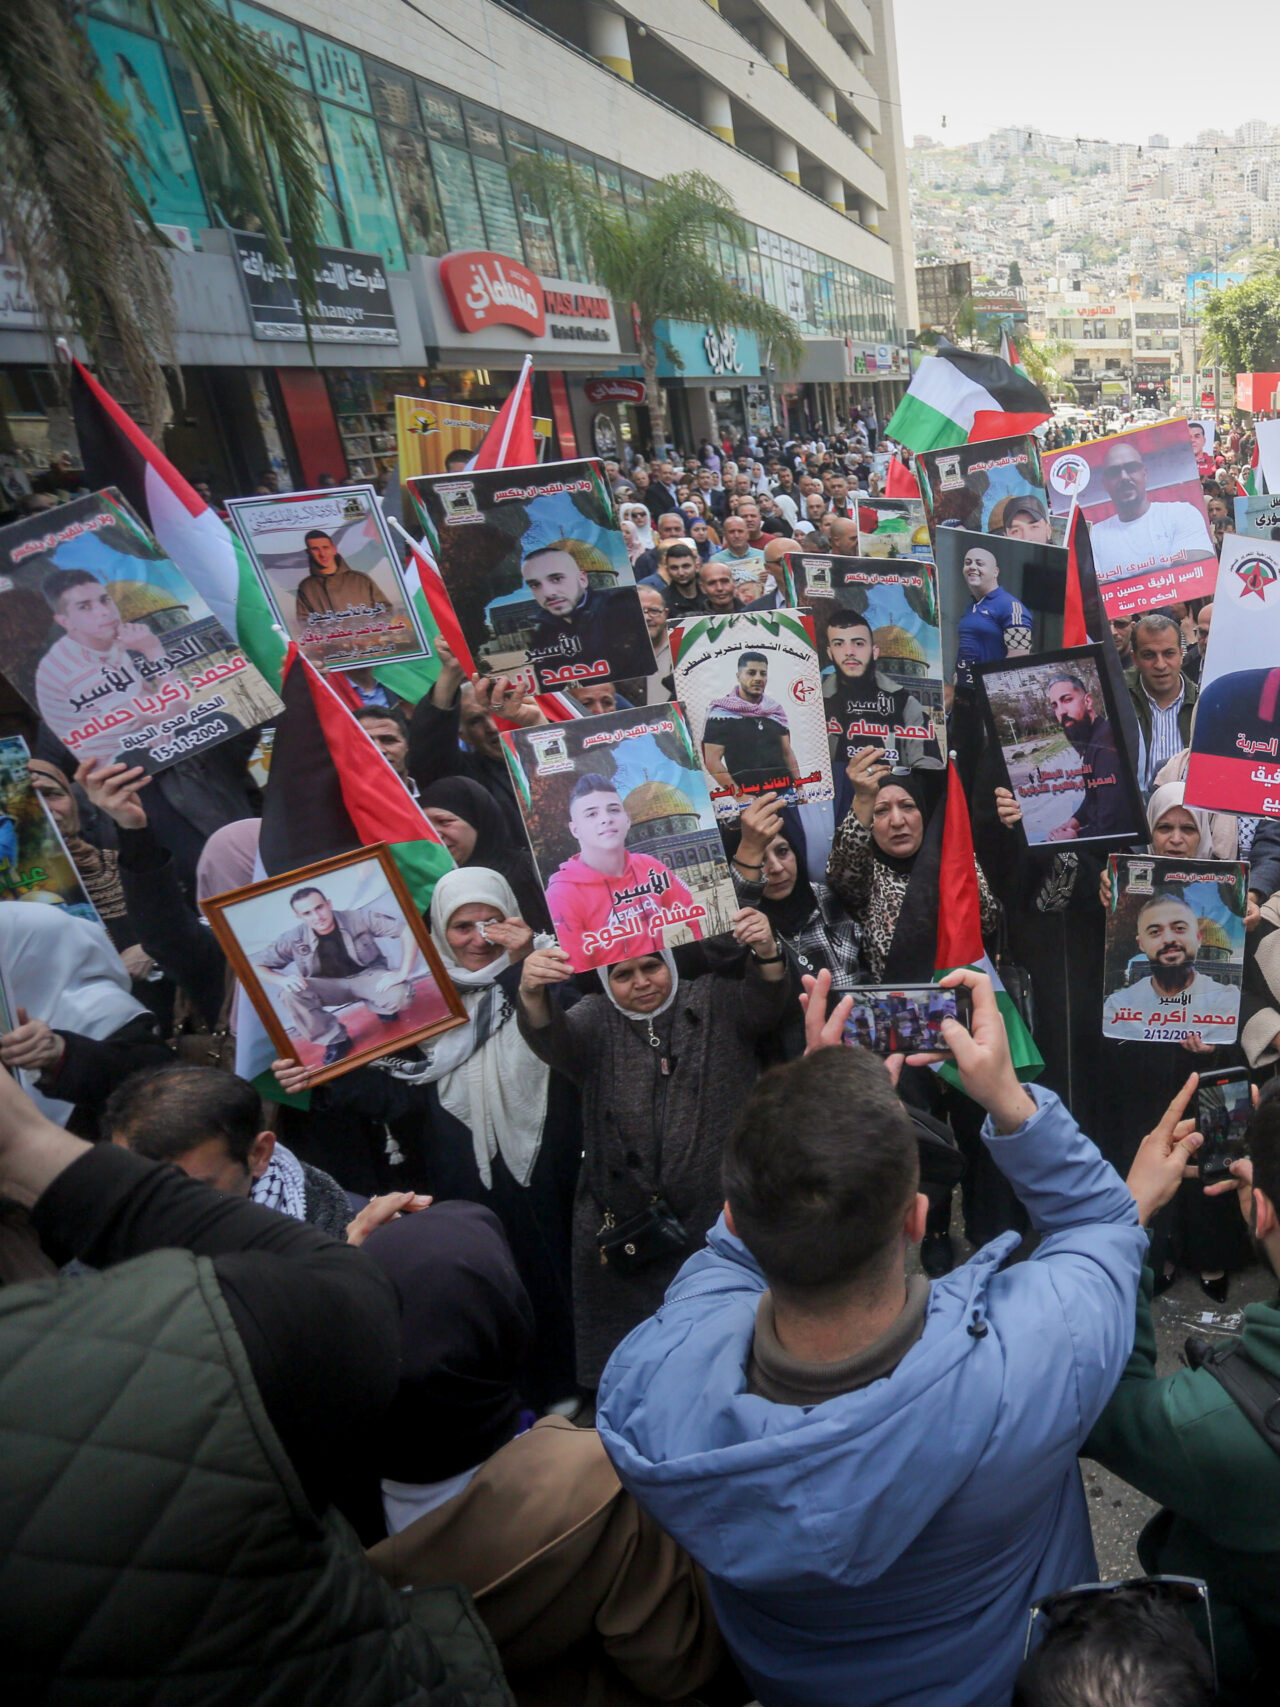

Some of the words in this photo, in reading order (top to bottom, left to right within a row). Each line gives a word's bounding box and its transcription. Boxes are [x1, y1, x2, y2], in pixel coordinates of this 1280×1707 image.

[466, 261, 539, 320] مسلماني
[494, 489, 526, 503] ينكسر
[539, 482, 563, 496] للقيد
[565, 483, 577, 492] بد
[578, 480, 592, 491] ولا
[1116, 583, 1146, 598] حسين
[1147, 573, 1176, 588] الرفيق
[1150, 588, 1179, 605] الحكم
[134, 634, 206, 684] الحرية
[190, 655, 248, 694] محمد
[540, 659, 611, 685] محمد
[69, 666, 136, 713] للأسير
[133, 679, 192, 716] زكريا
[188, 695, 227, 724] الحكم
[63, 706, 136, 750] حمامي
[159, 715, 187, 737] مدى
[625, 722, 648, 738] للقيد
[650, 724, 660, 733] بد
[660, 720, 674, 731] ولا
[847, 718, 889, 741] بسام
[893, 719, 935, 740] أحمد
[120, 726, 159, 750] الحياة
[150, 720, 230, 764] 15-11-2004
[583, 734, 613, 748] ينكسر
[1235, 732, 1279, 757] الحرية
[612, 868, 672, 907] الأسير
[649, 901, 708, 937] هشام
[1157, 991, 1192, 1006] الأسير
[1110, 1006, 1143, 1025] عنتر
[1147, 1007, 1188, 1027] أكرم
[1192, 1010, 1237, 1026] محمد
